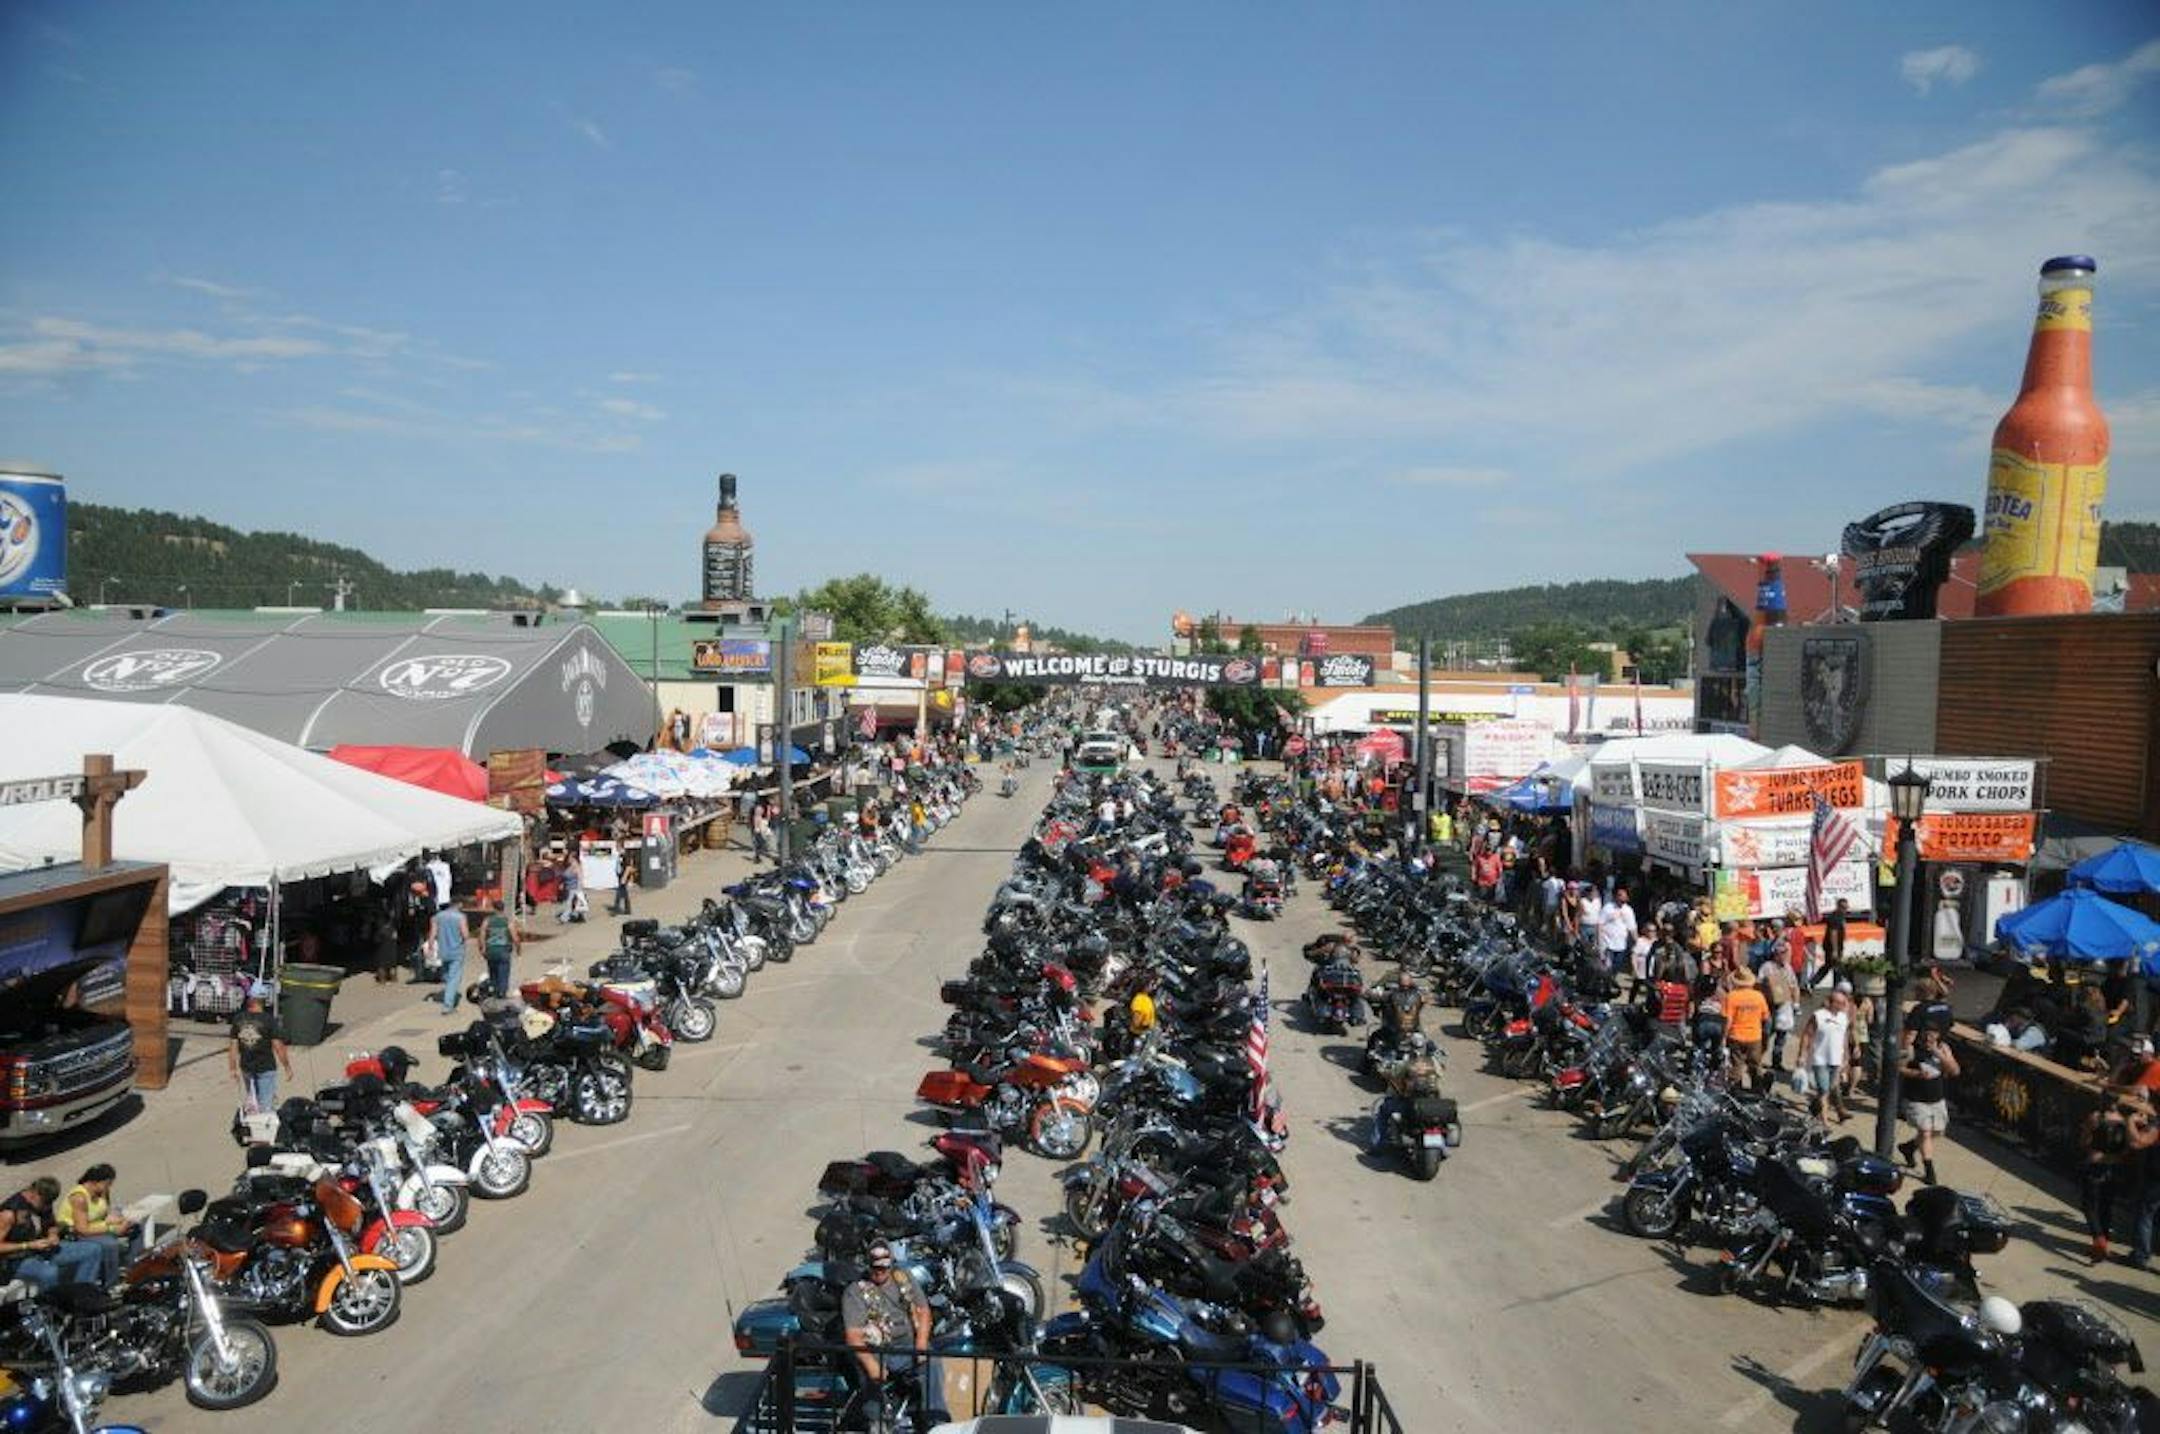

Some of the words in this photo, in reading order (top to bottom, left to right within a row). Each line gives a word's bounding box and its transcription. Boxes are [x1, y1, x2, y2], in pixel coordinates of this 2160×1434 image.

[1005, 656, 1106, 678] WELCOME
[1132, 657, 1222, 682] STURGIS
[1768, 771, 1807, 787] JUMBO
[1977, 770, 2029, 782] SMOKED
[1927, 786, 1969, 799] PORK
[1976, 785, 2028, 800] CHOPS
[1938, 832, 2001, 846] POTATO
